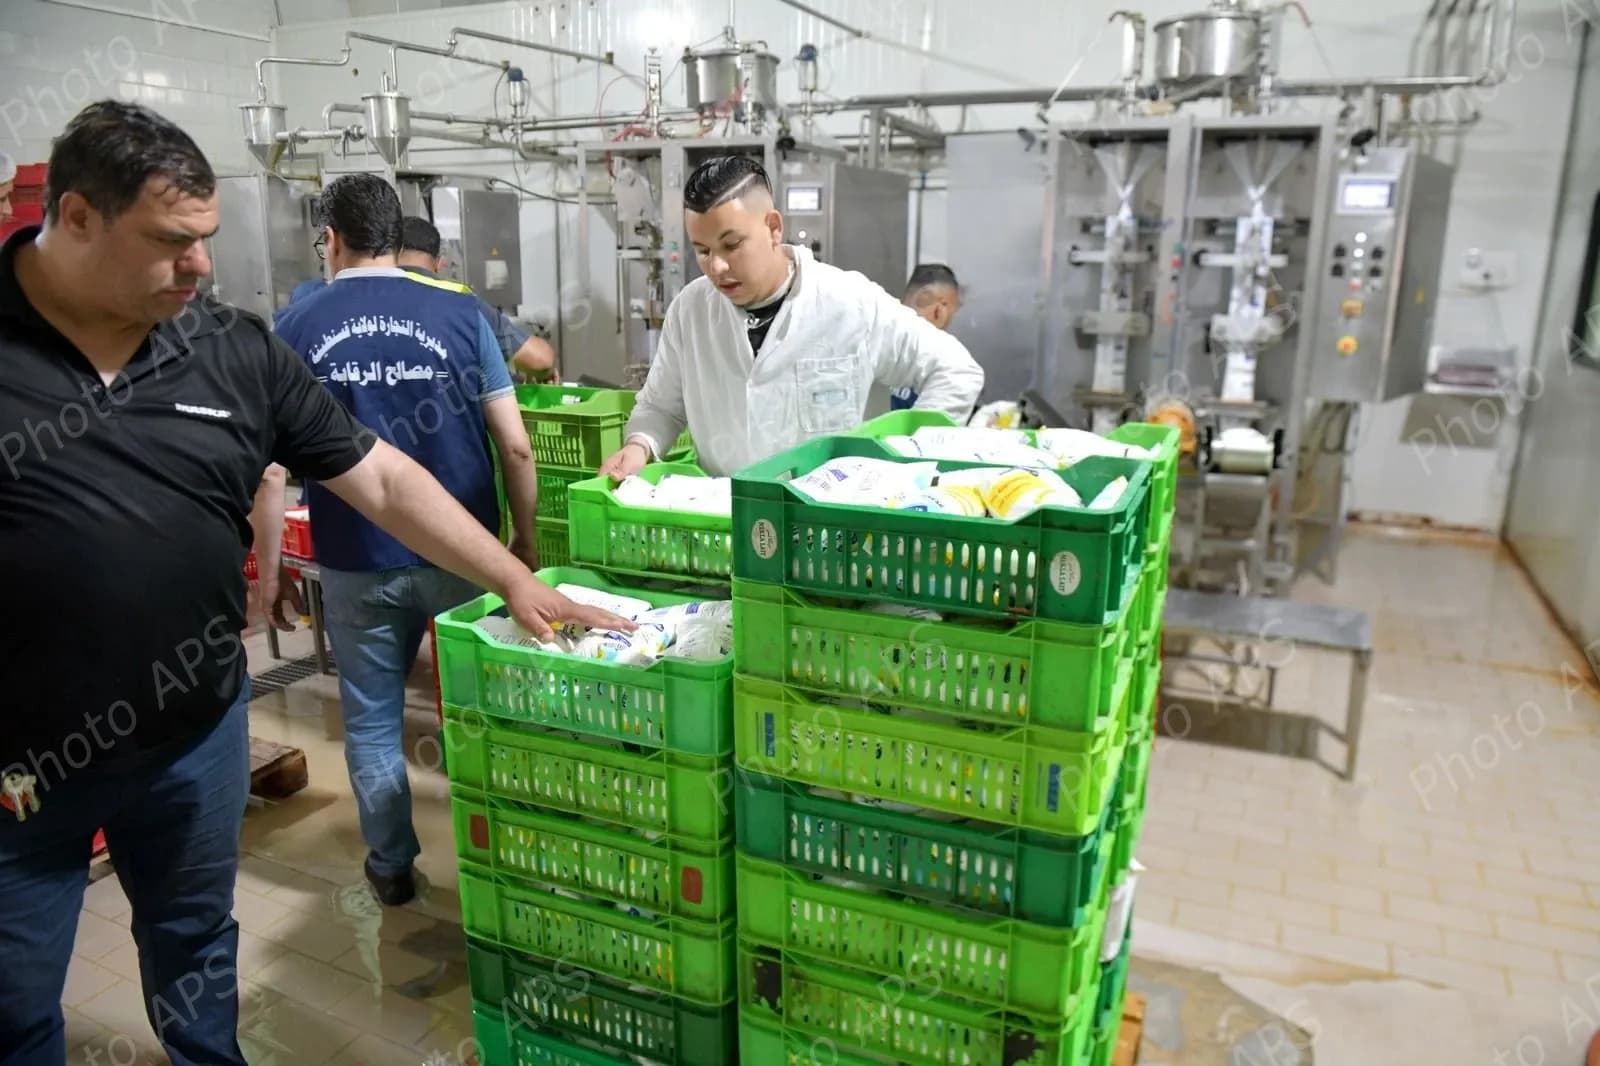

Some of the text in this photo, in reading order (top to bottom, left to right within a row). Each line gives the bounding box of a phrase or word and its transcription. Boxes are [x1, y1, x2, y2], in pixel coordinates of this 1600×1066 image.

[308, 315, 448, 364] مديرية التجارة لولاية قسنطينة
[330, 360, 434, 387] مصالح الرقابة
